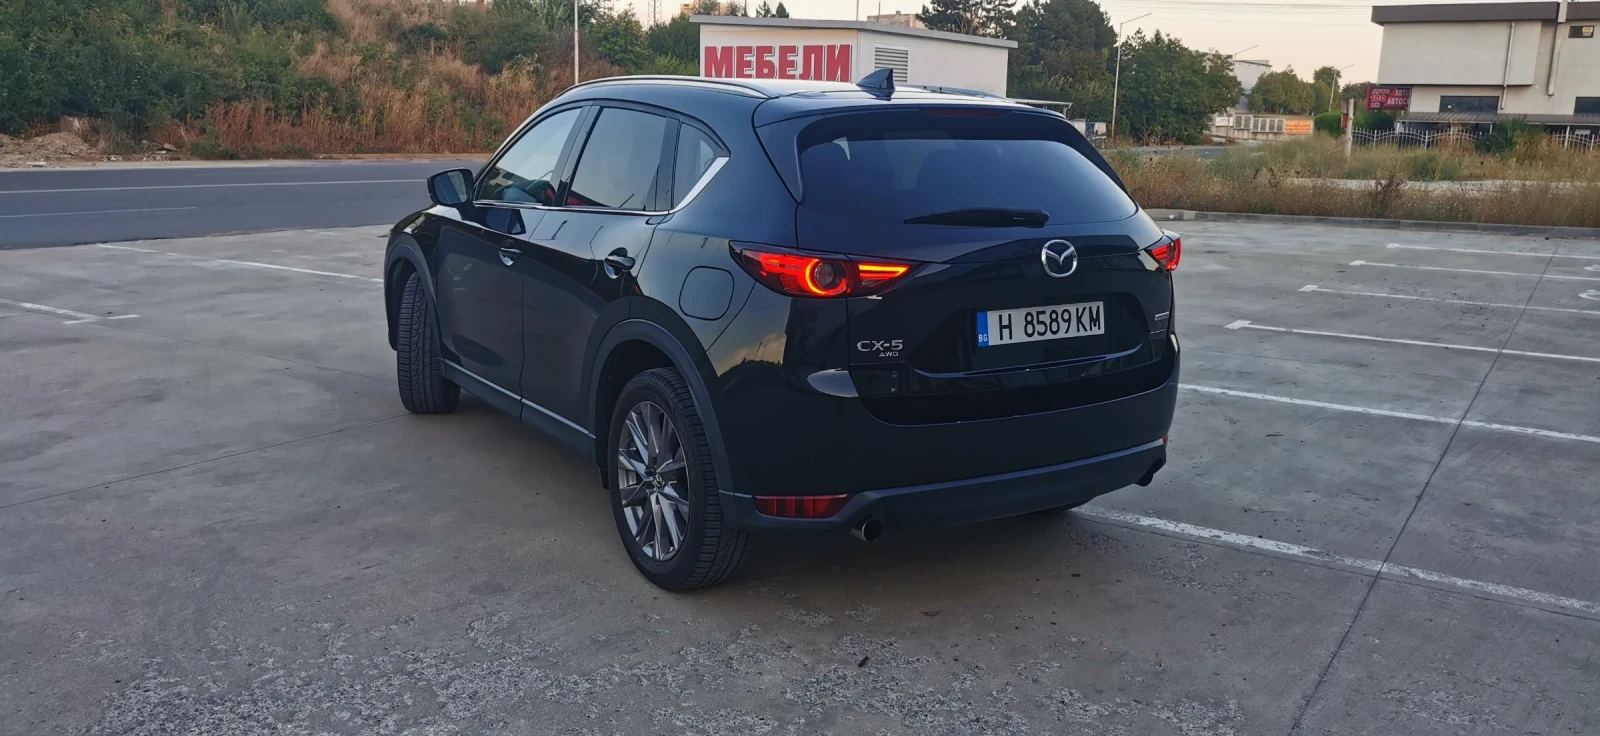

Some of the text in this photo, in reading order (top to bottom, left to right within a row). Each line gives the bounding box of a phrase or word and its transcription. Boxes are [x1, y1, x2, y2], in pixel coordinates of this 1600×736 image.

[704, 44, 852, 82] МЕБЕЛИ
[998, 305, 1101, 341] H 8589 KM
[857, 339, 904, 352] CX-5
[978, 333, 988, 343] BG
